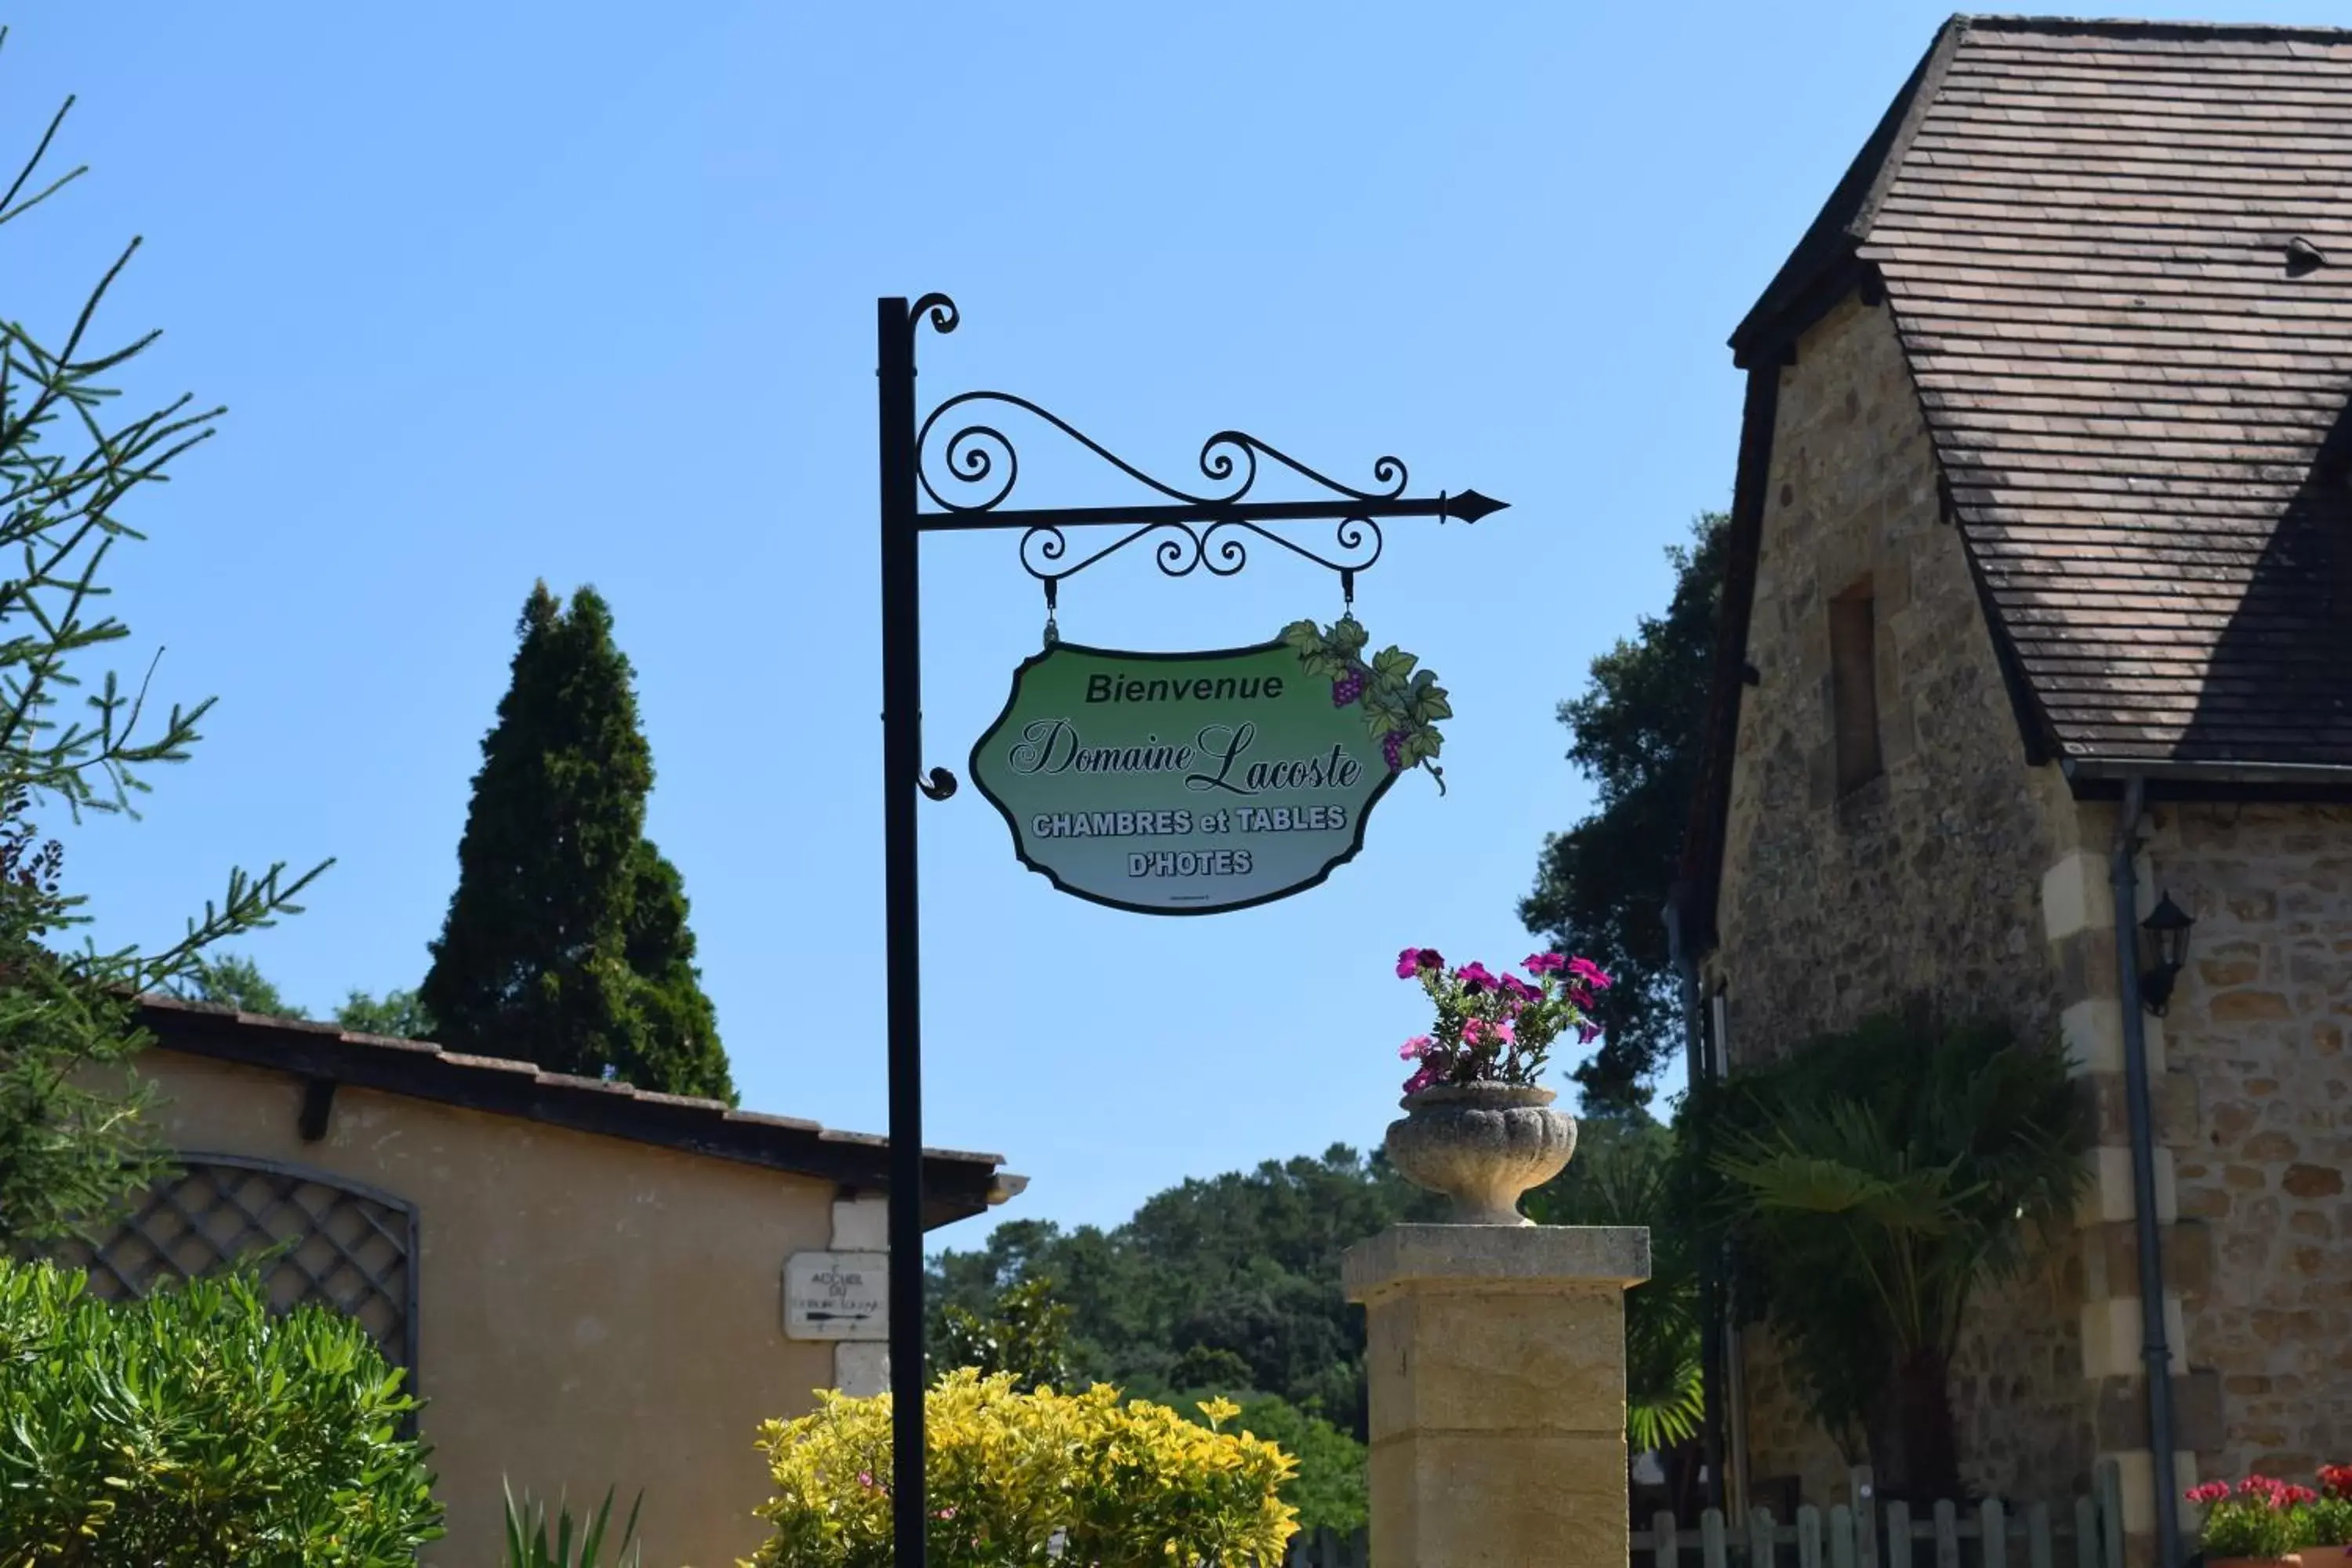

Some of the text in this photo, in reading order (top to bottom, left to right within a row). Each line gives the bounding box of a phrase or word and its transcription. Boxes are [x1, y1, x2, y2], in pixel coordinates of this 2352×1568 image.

[1085, 673, 1284, 703] Bienvenue
[1009, 717, 1363, 796] Domaine Lacoste
[1031, 805, 1347, 838] CHAMBRES et TABLES
